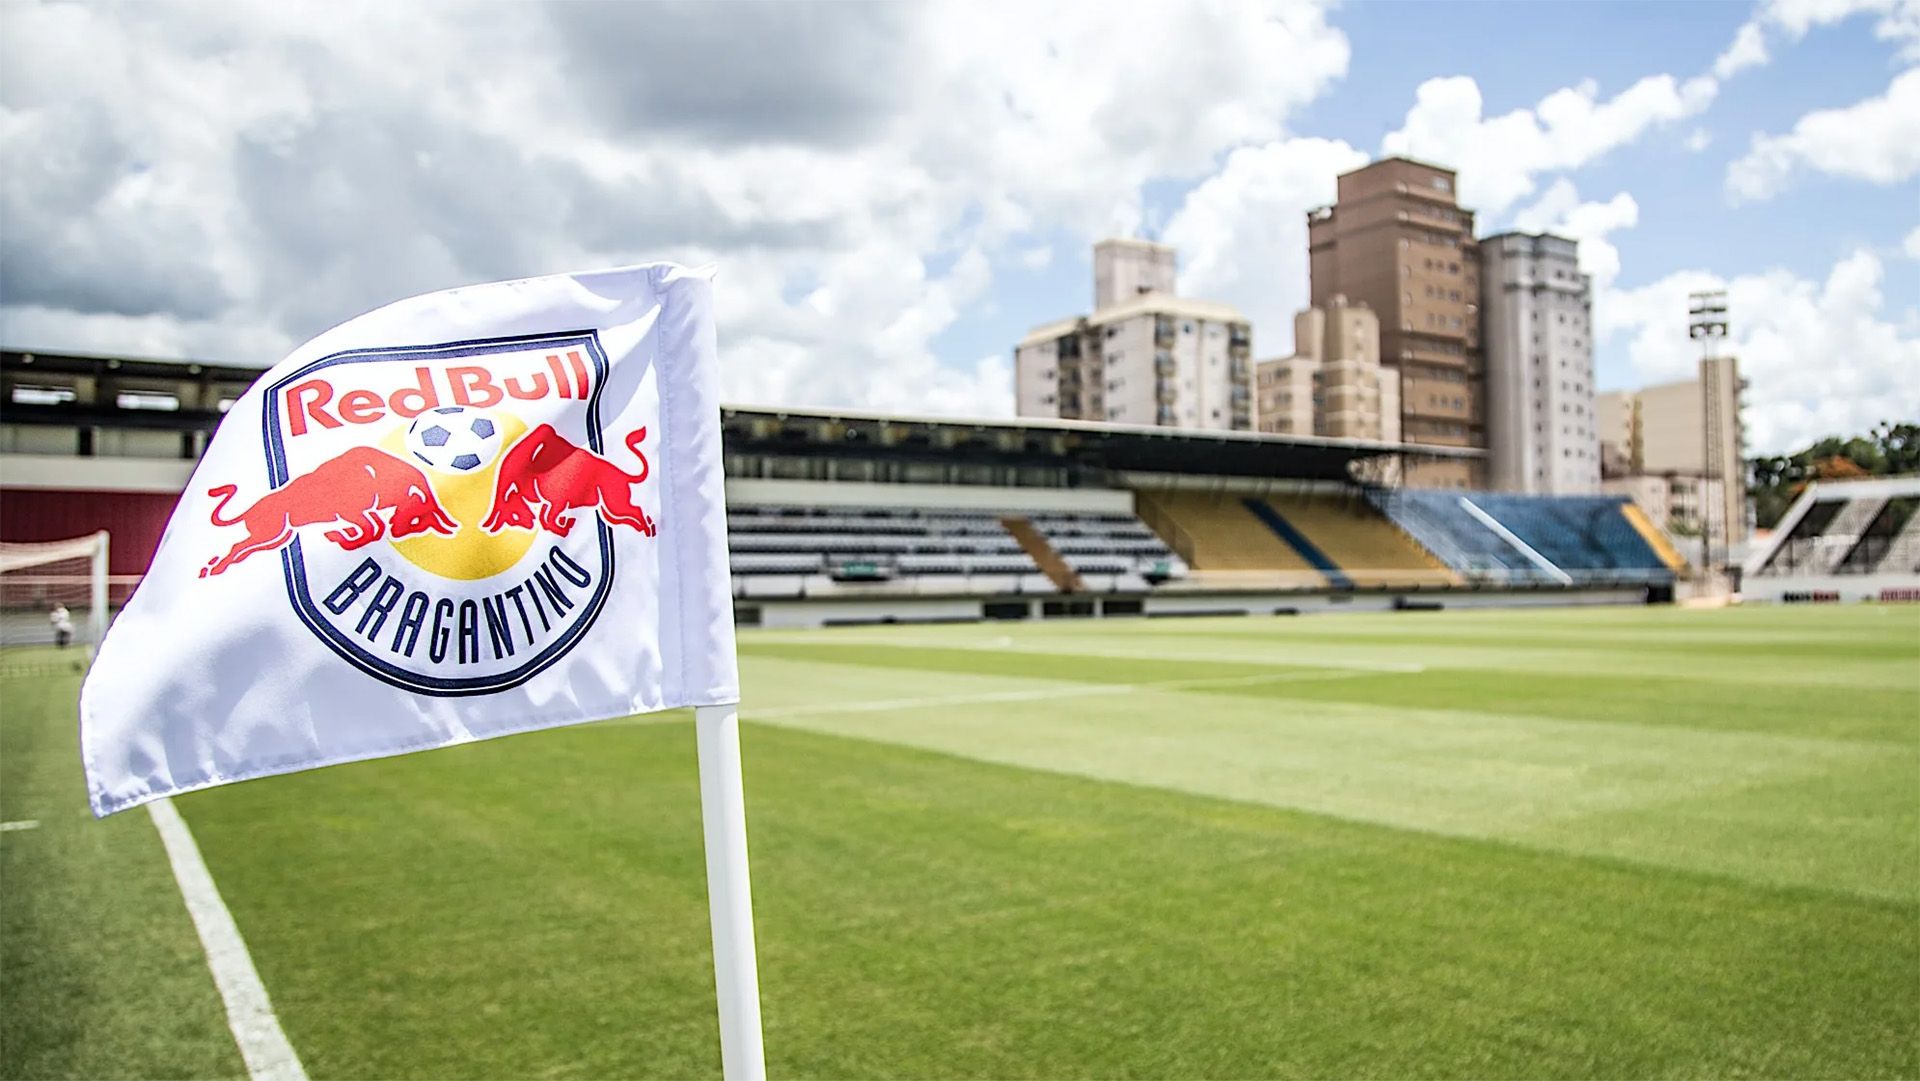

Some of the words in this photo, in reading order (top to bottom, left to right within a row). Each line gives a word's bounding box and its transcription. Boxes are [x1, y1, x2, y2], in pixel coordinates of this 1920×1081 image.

[286, 367, 440, 436] Red
[445, 351, 589, 408] Bull
[322, 545, 591, 664] BRAGANTINO
